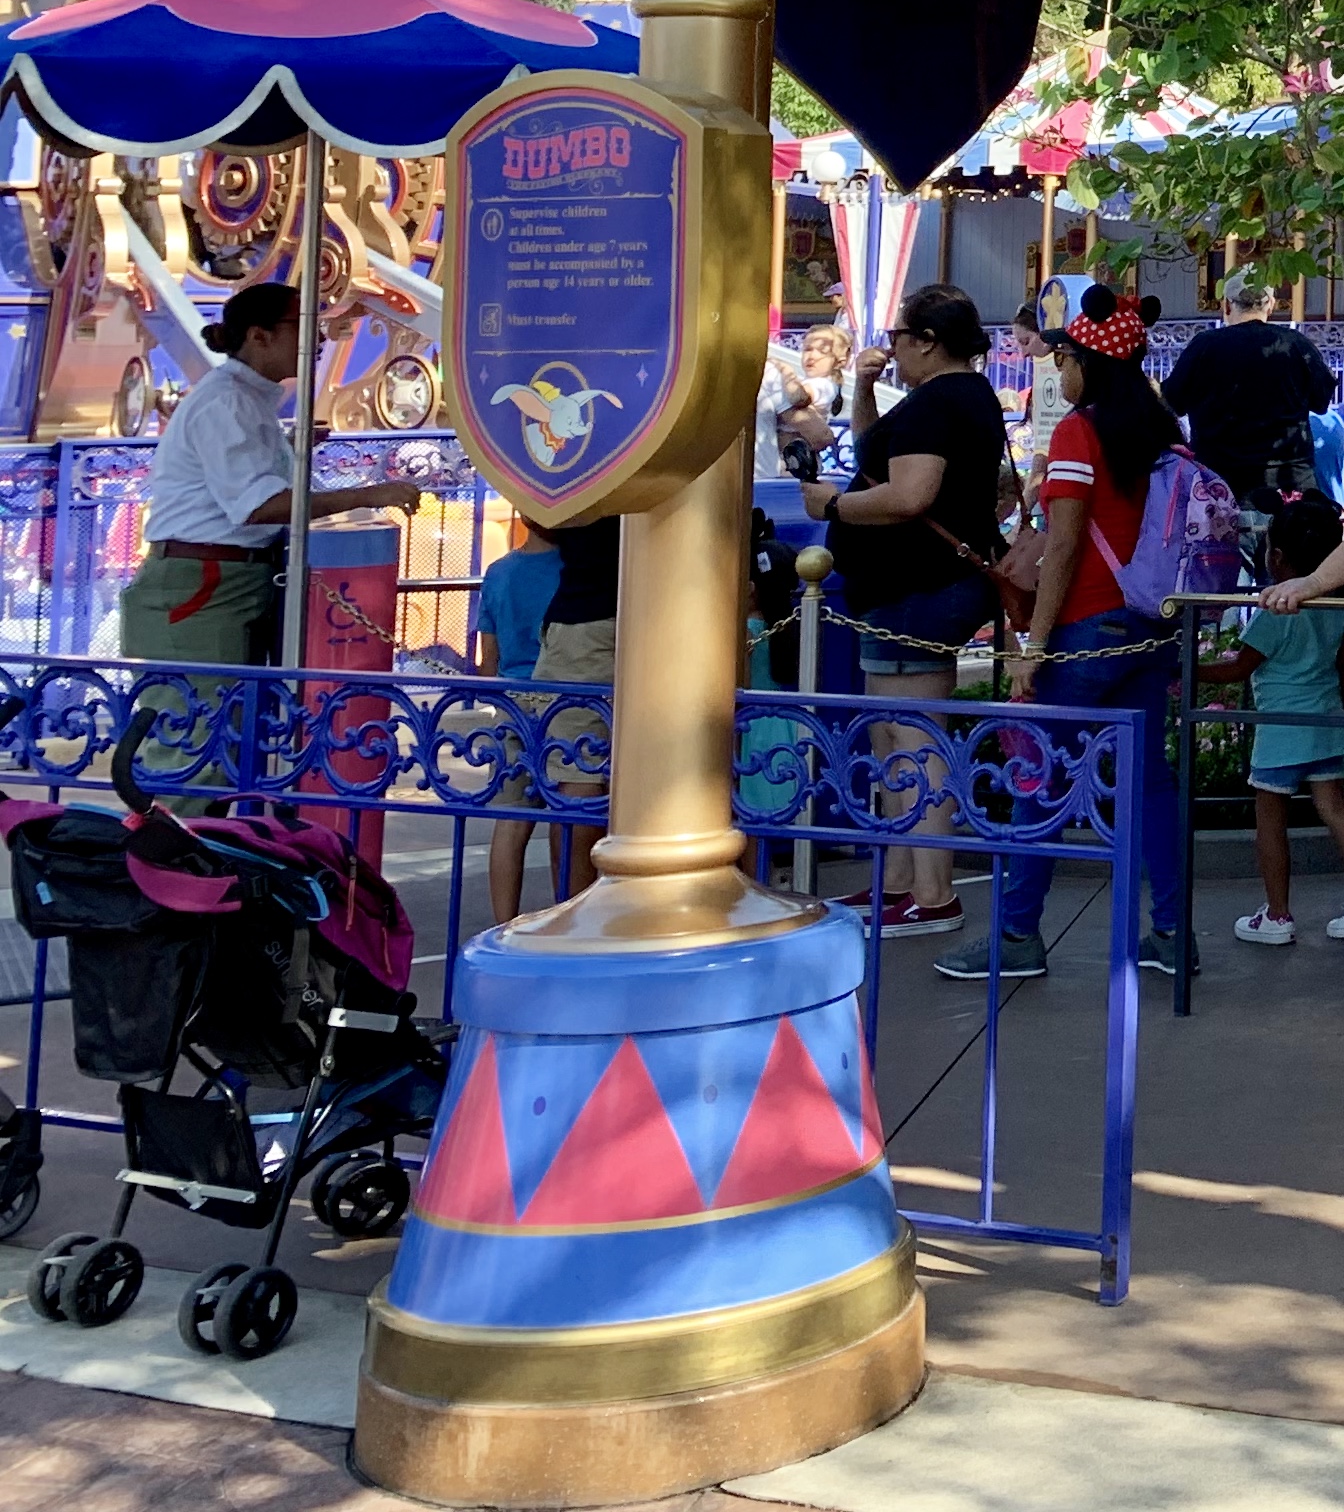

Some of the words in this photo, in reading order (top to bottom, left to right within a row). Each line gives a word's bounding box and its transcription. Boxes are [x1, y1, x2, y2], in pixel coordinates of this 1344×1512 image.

[502, 126, 631, 179] DUMBO
[510, 207, 558, 221] Supervise
[562, 206, 607, 218] children
[509, 226, 518, 236] at
[521, 224, 533, 236] all
[508, 240, 551, 253] Children
[554, 239, 584, 252] under
[587, 243, 606, 254] age
[609, 239, 616, 251] 7
[618, 242, 648, 255] years
[508, 261, 531, 271] must
[534, 259, 545, 270] be
[548, 257, 617, 272] accompanied
[621, 257, 633, 272] by
[637, 259, 644, 269] a
[507, 279, 540, 291] person
[543, 279, 560, 292] age
[564, 275, 575, 287] 14
[577, 277, 604, 290] years
[609, 278, 619, 287] or
[624, 274, 654, 286] older.
[507, 314, 532, 326] Must
[535, 313, 577, 326] transfer
